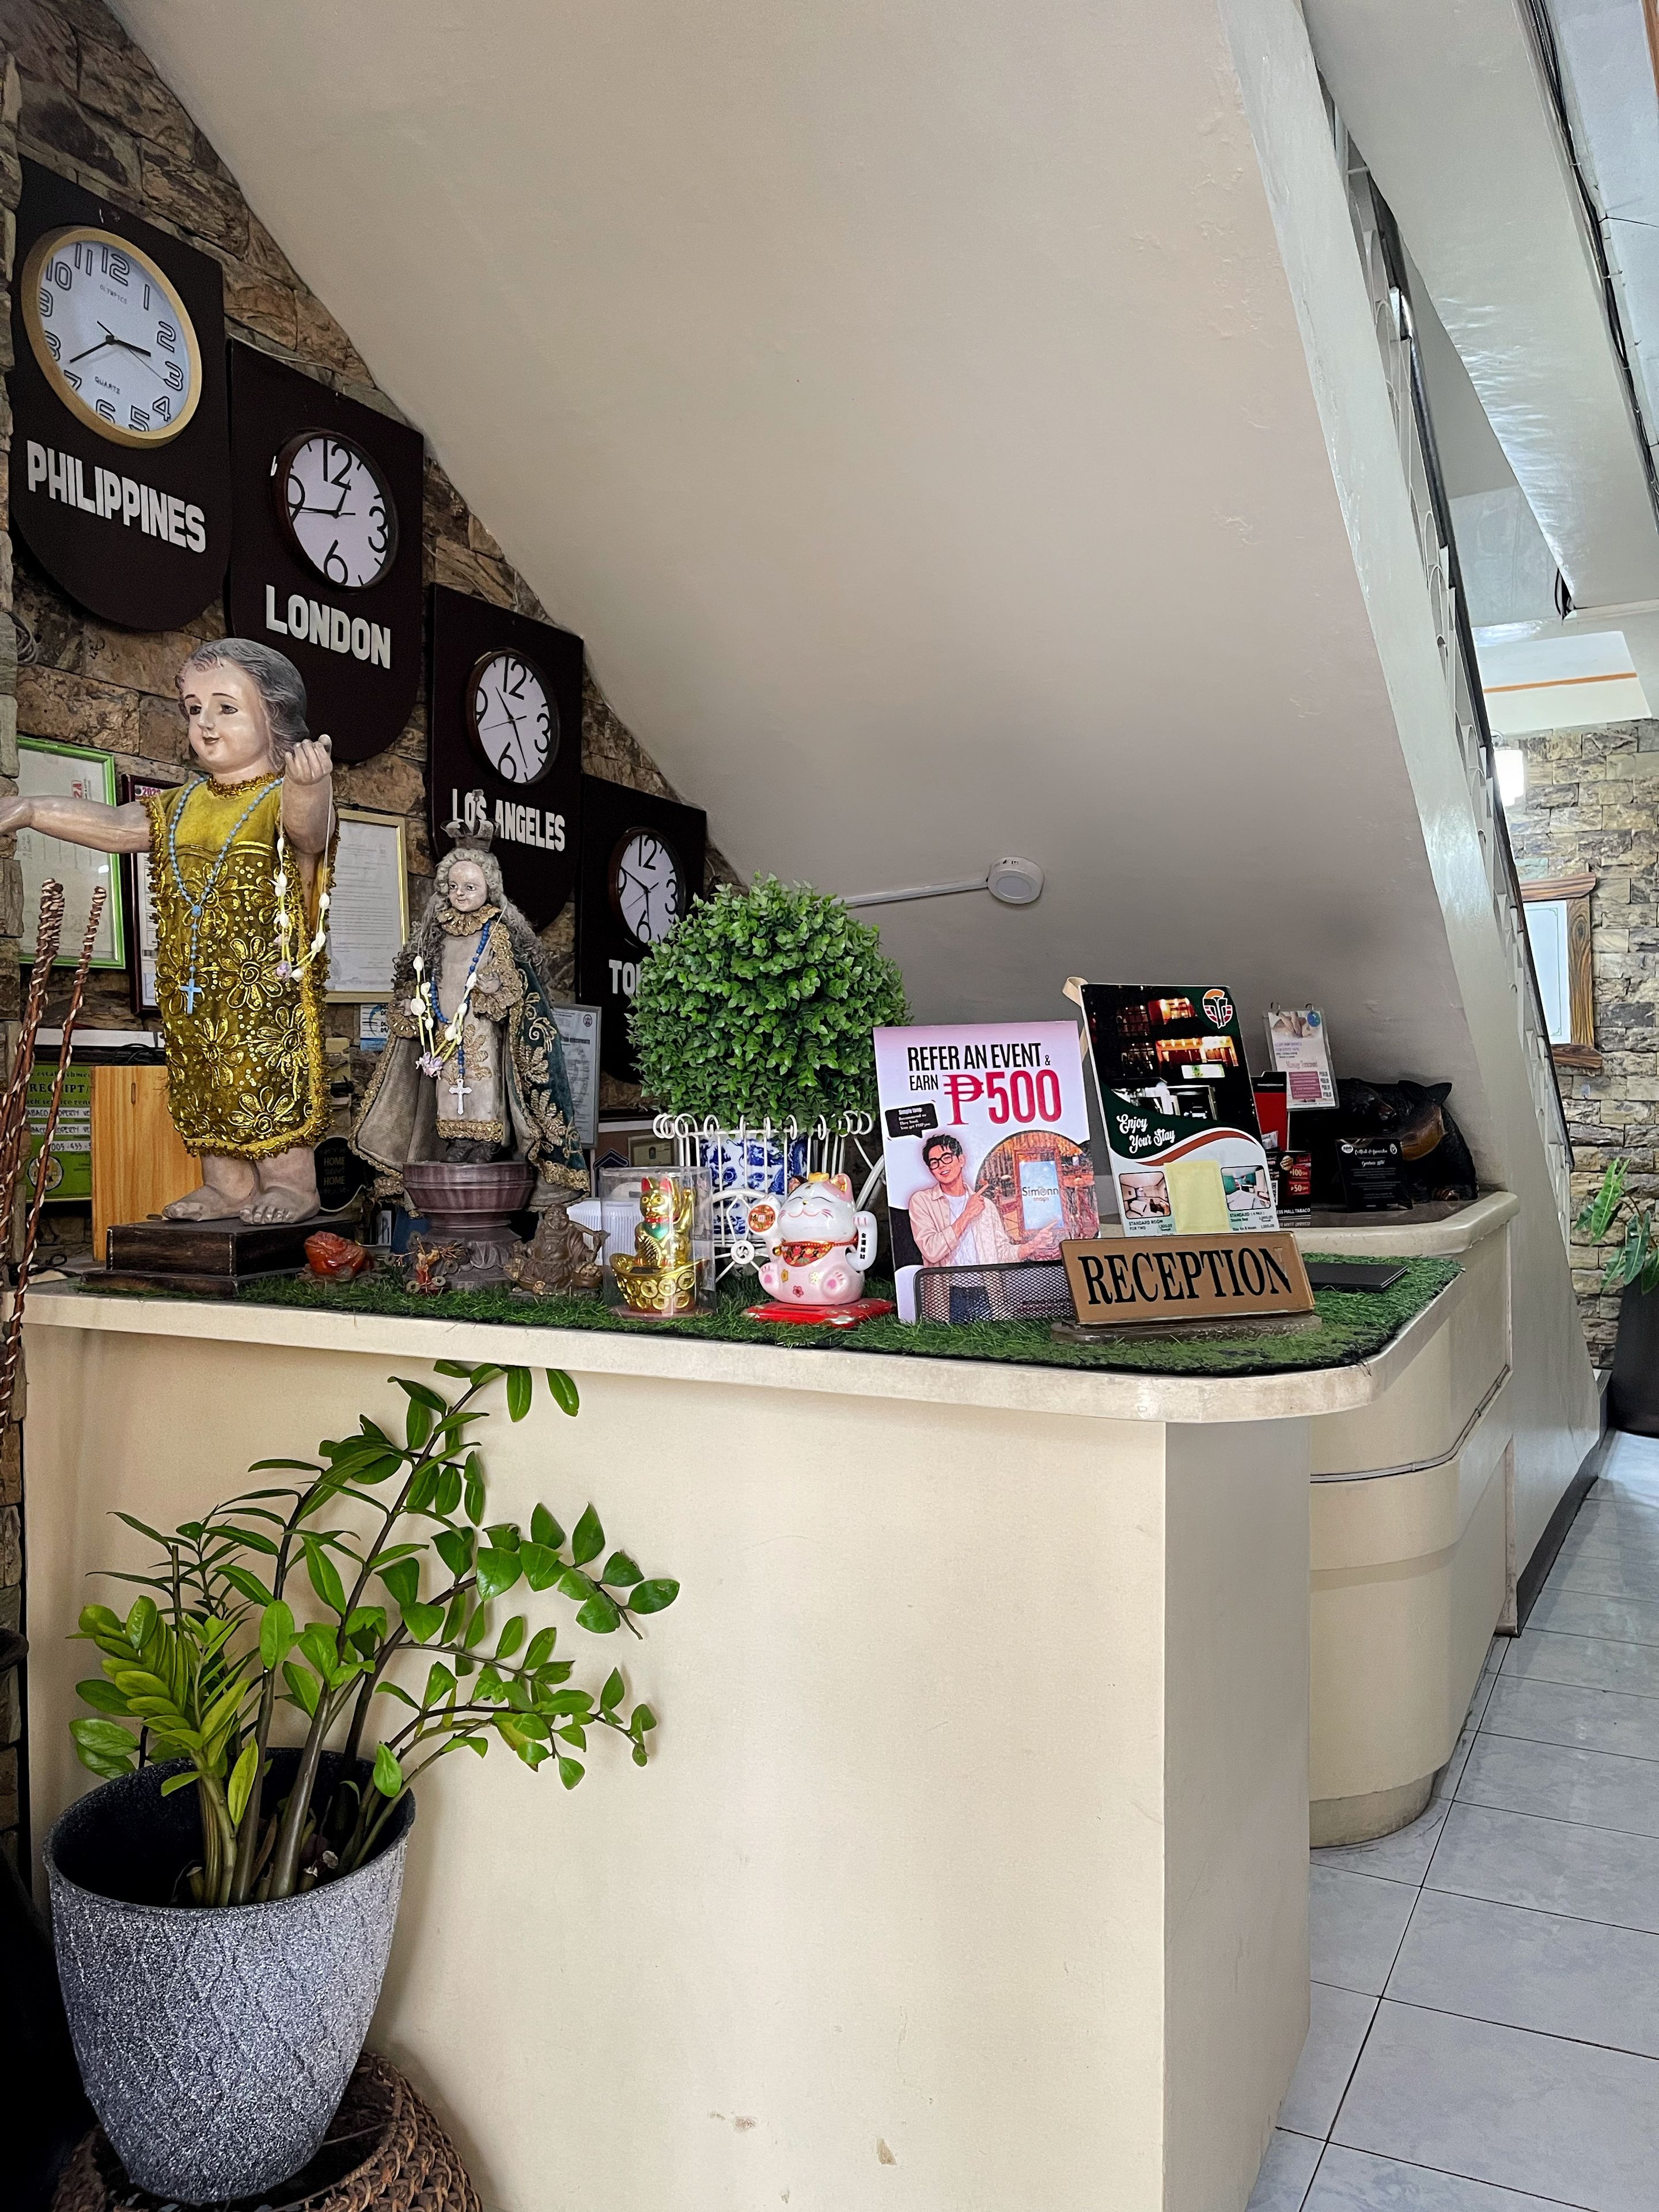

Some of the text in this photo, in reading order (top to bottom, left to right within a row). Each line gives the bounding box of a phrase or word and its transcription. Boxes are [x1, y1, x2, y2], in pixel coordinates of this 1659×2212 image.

[46, 257, 72, 291] 10
[74, 244, 92, 276] 11
[102, 247, 130, 286] 12
[143, 284, 150, 310] 1
[157, 321, 176, 353] 2
[94, 376, 120, 395] QUARTZ
[164, 361, 183, 391] 3
[129, 405, 150, 432] 5
[153, 396, 171, 421] 4
[323, 438, 352, 491] 12
[27, 440, 206, 553] PHILIPPINES
[368, 506, 388, 554] 3
[323, 539, 348, 585] 6
[266, 584, 391, 669] LONDON
[503, 656, 527, 700] 12
[534, 713, 551, 753] 3
[498, 741, 517, 782] 6
[495, 799, 565, 852] ANGELES
[638, 835, 657, 870] 12
[665, 878, 678, 915] 3
[636, 910, 652, 944] 6
[907, 1043, 1051, 1071] REFER AN EVENT &
[910, 1074, 939, 1091] EARN
[1116, 1113, 1148, 1134] Enjoy
[1129, 1128, 1176, 1154] Your Stay
[324, 1156, 346, 1166] HOME
[323, 1176, 346, 1185] HOME
[1078, 1247, 1293, 1305] RECEPTION
